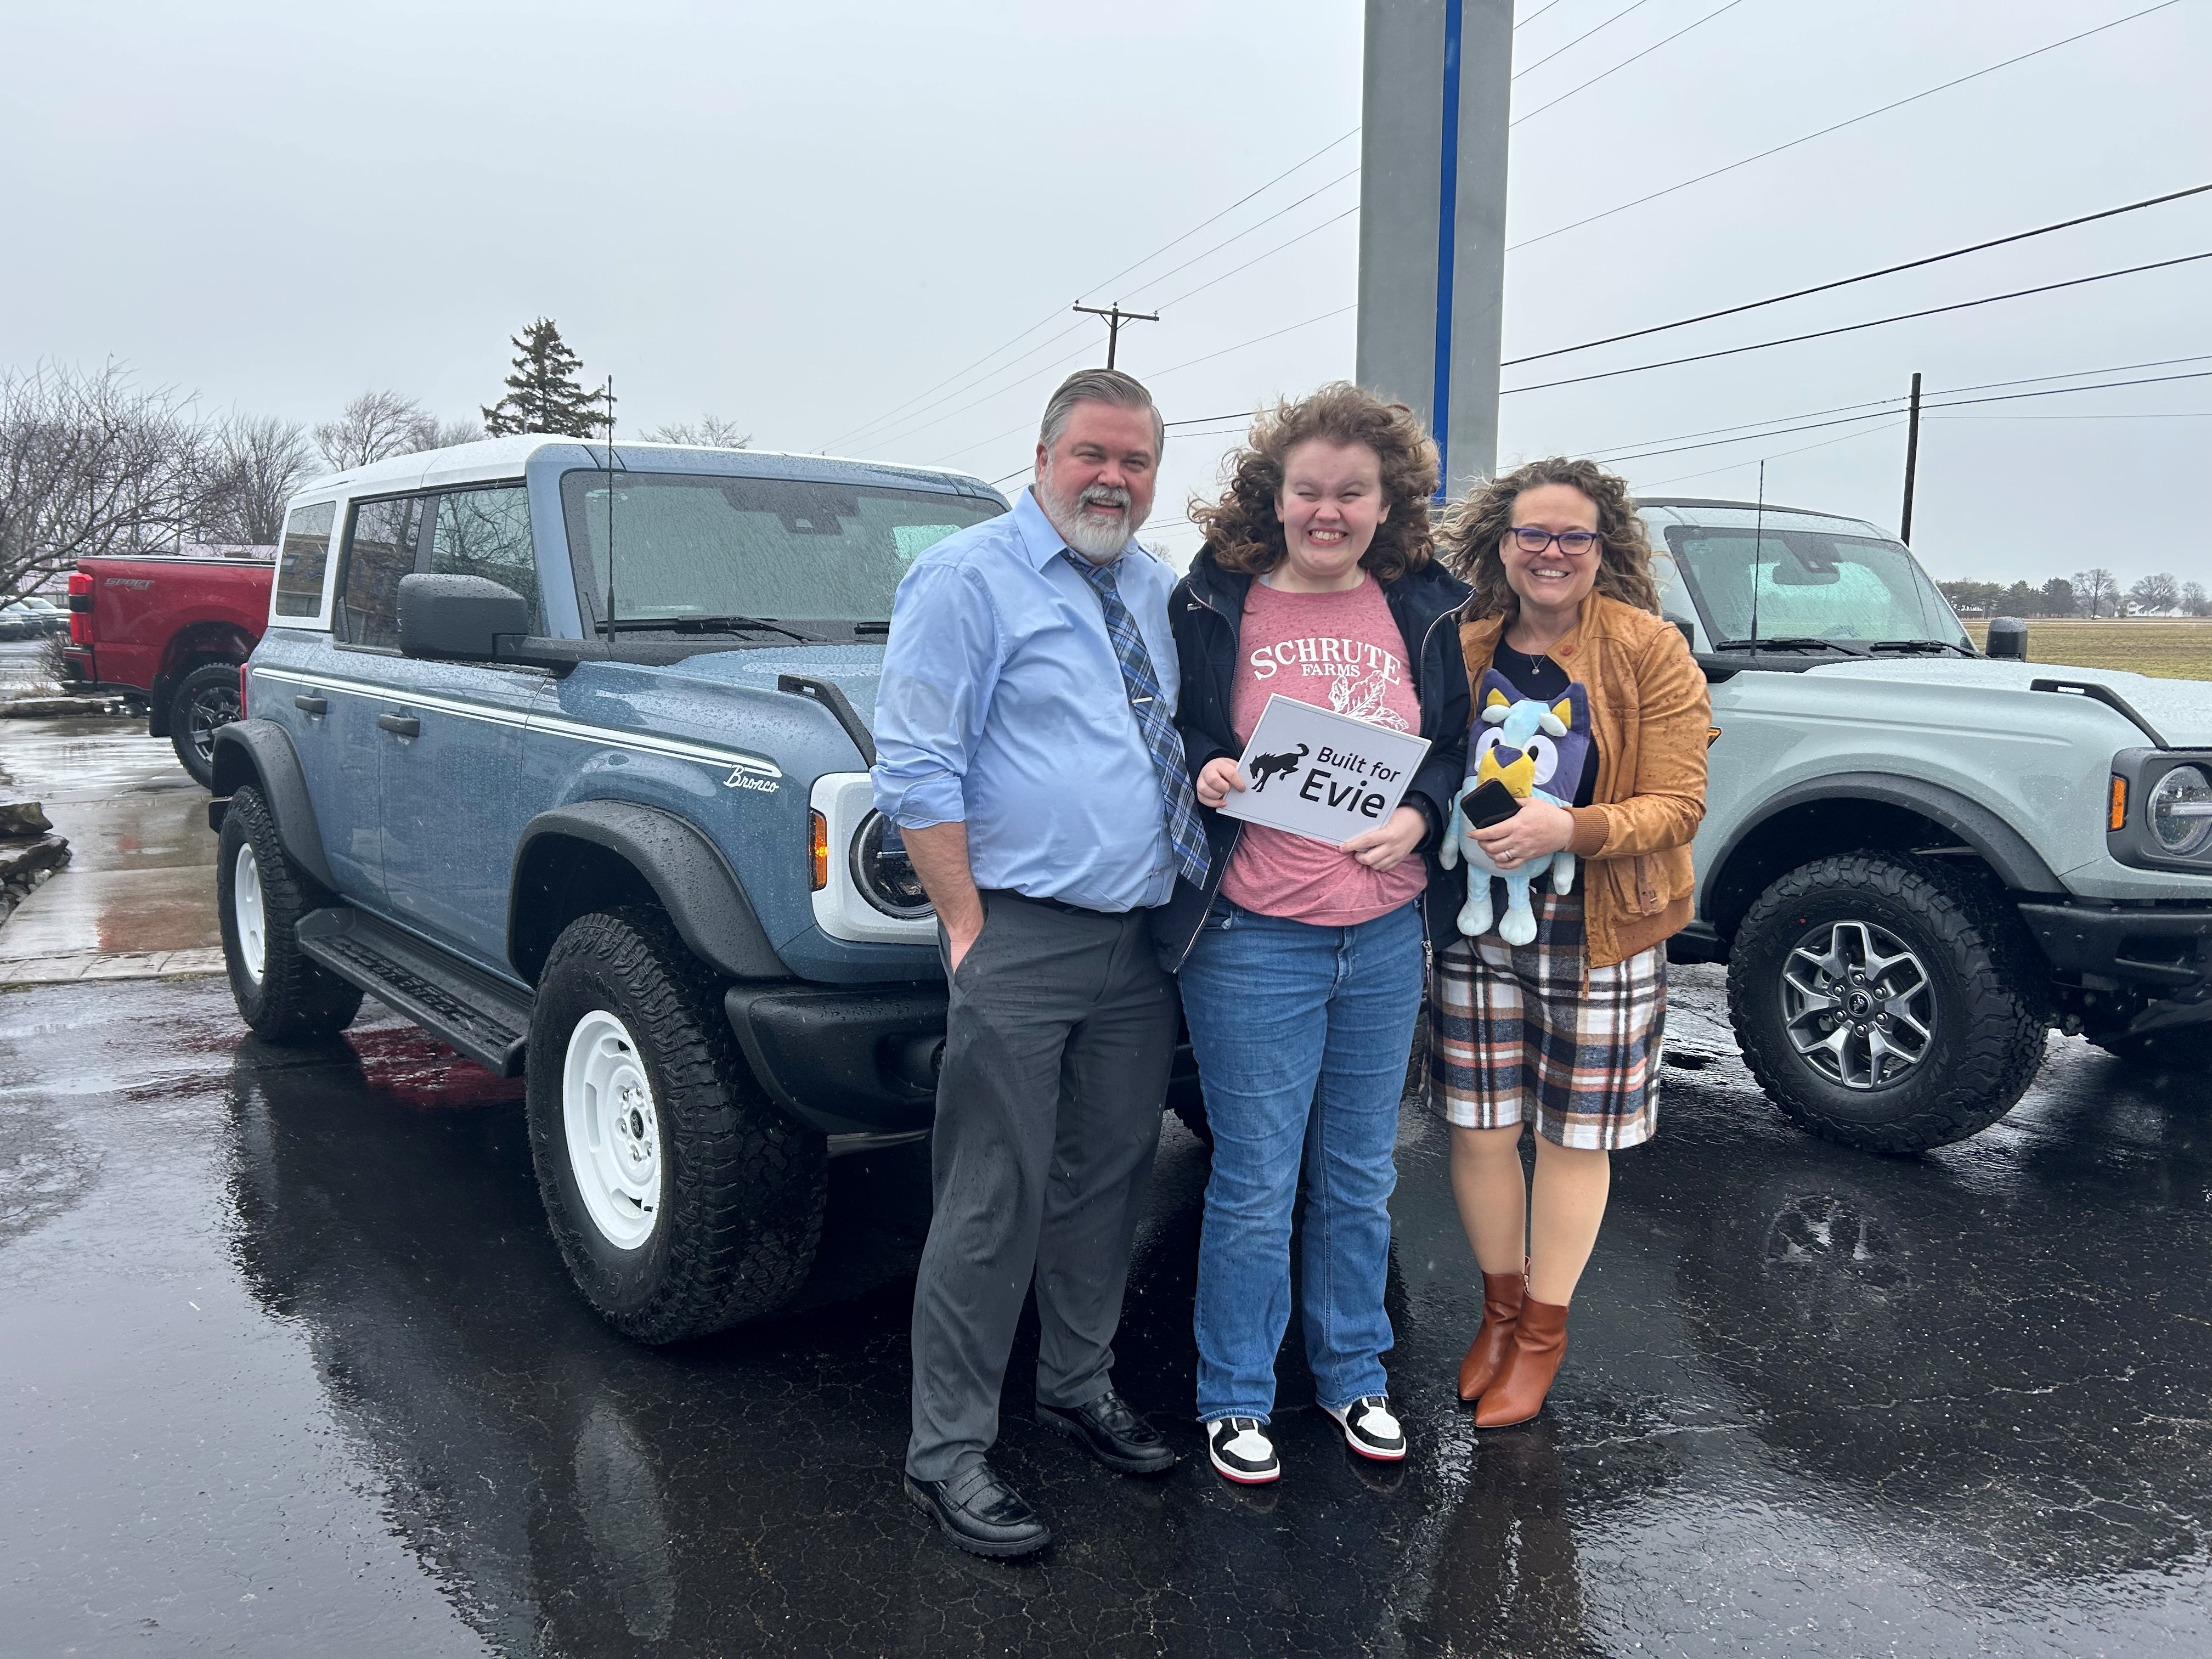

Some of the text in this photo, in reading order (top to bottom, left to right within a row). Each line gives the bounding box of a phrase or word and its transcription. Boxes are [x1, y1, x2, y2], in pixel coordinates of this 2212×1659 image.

[104, 578, 155, 587] SPORT
[1250, 637, 1401, 685] SCHRUTE
[1301, 662, 1361, 678] FARMS
[723, 764, 780, 793] Bronco
[1317, 746, 1401, 782] Built for
[1299, 769, 1386, 819] Evie
